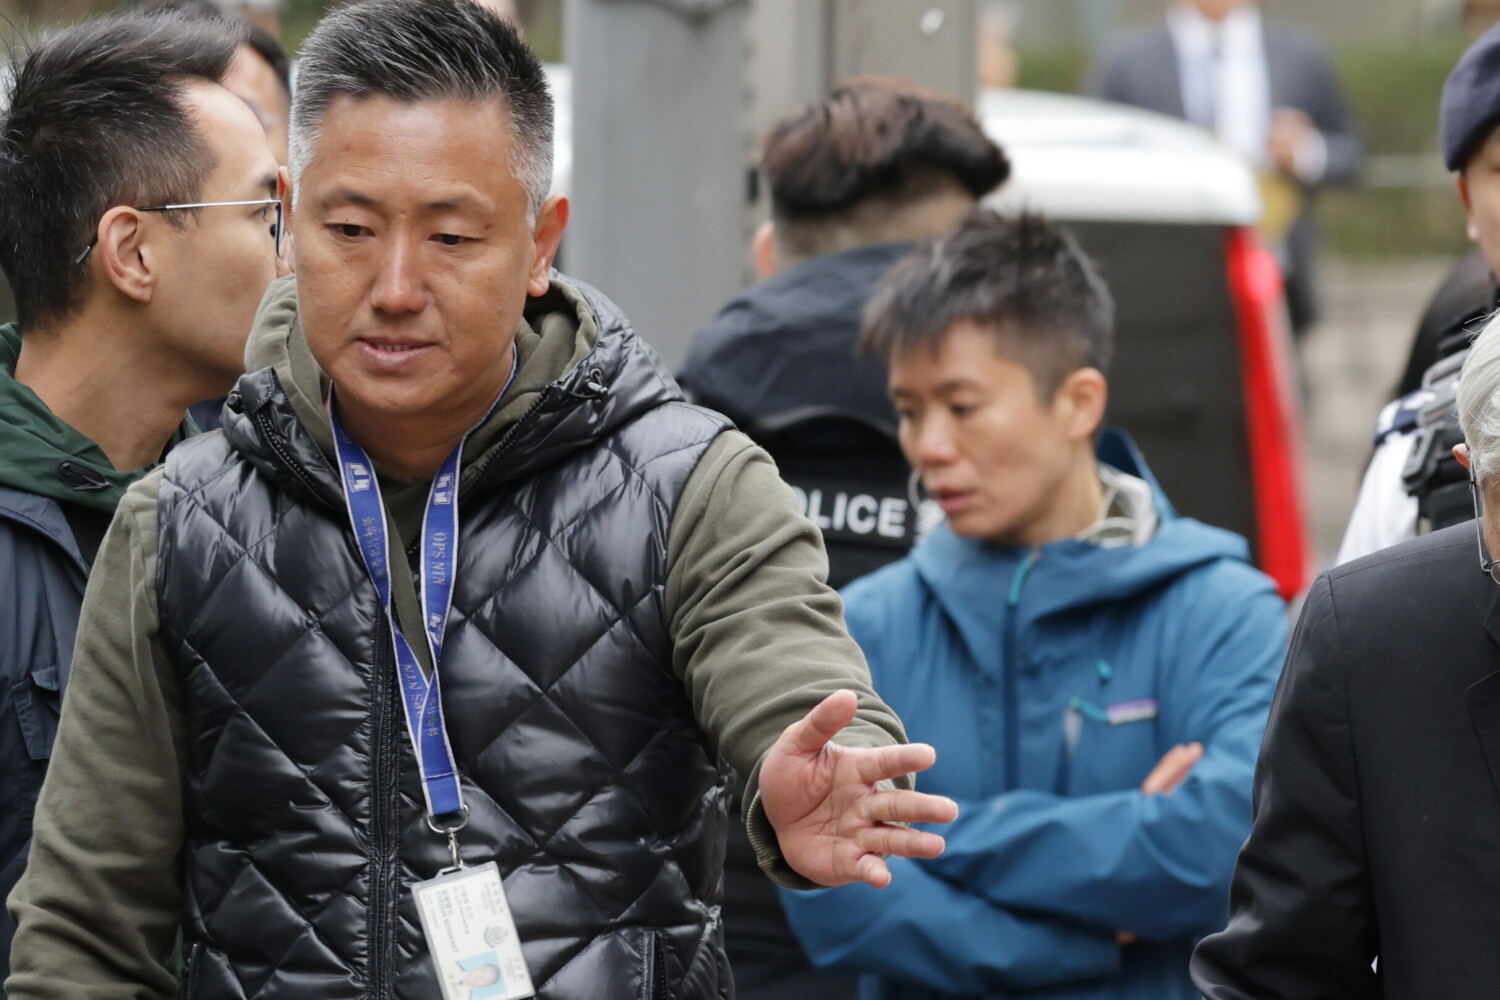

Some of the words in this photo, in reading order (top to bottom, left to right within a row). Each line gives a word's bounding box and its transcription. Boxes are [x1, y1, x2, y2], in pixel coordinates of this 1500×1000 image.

[793, 486, 908, 538] LICE
[431, 532, 446, 558] OPS
[431, 562, 444, 584] NTN
